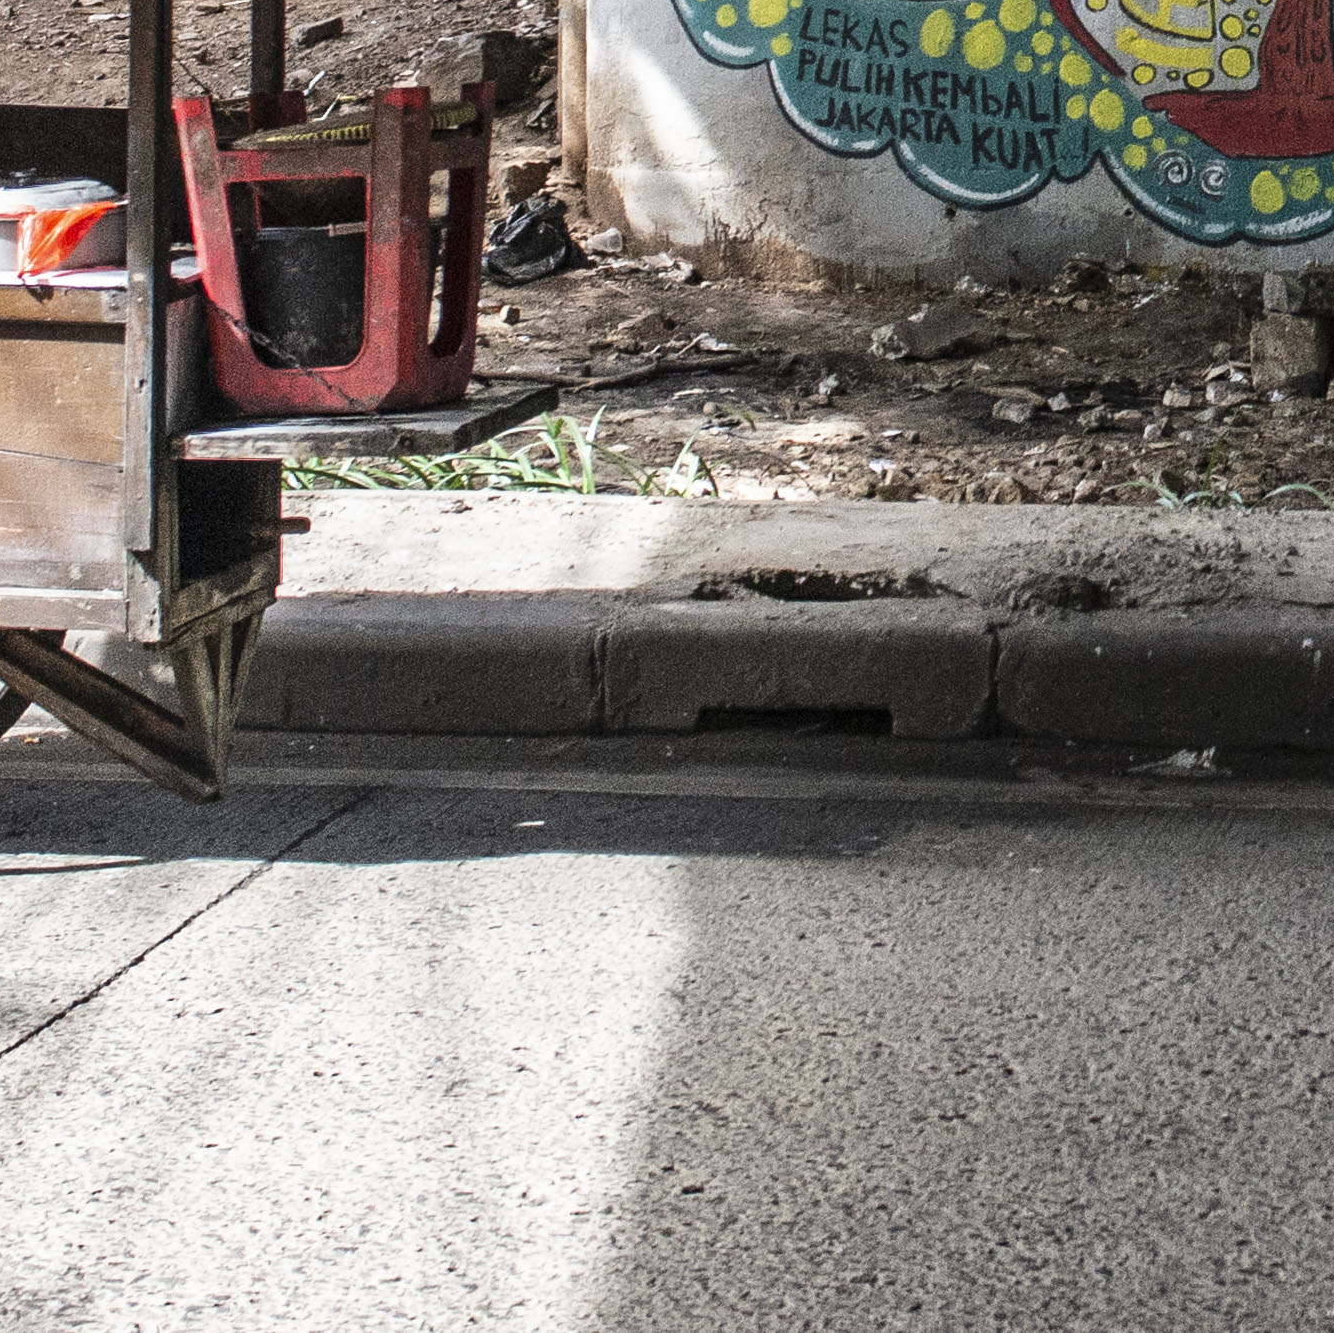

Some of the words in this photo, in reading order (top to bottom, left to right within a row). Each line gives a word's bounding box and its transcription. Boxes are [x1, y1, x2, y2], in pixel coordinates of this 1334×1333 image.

[796, 6, 911, 58] LEKAS
[795, 49, 896, 97] PULIH
[818, 97, 962, 146] JAKARTA
